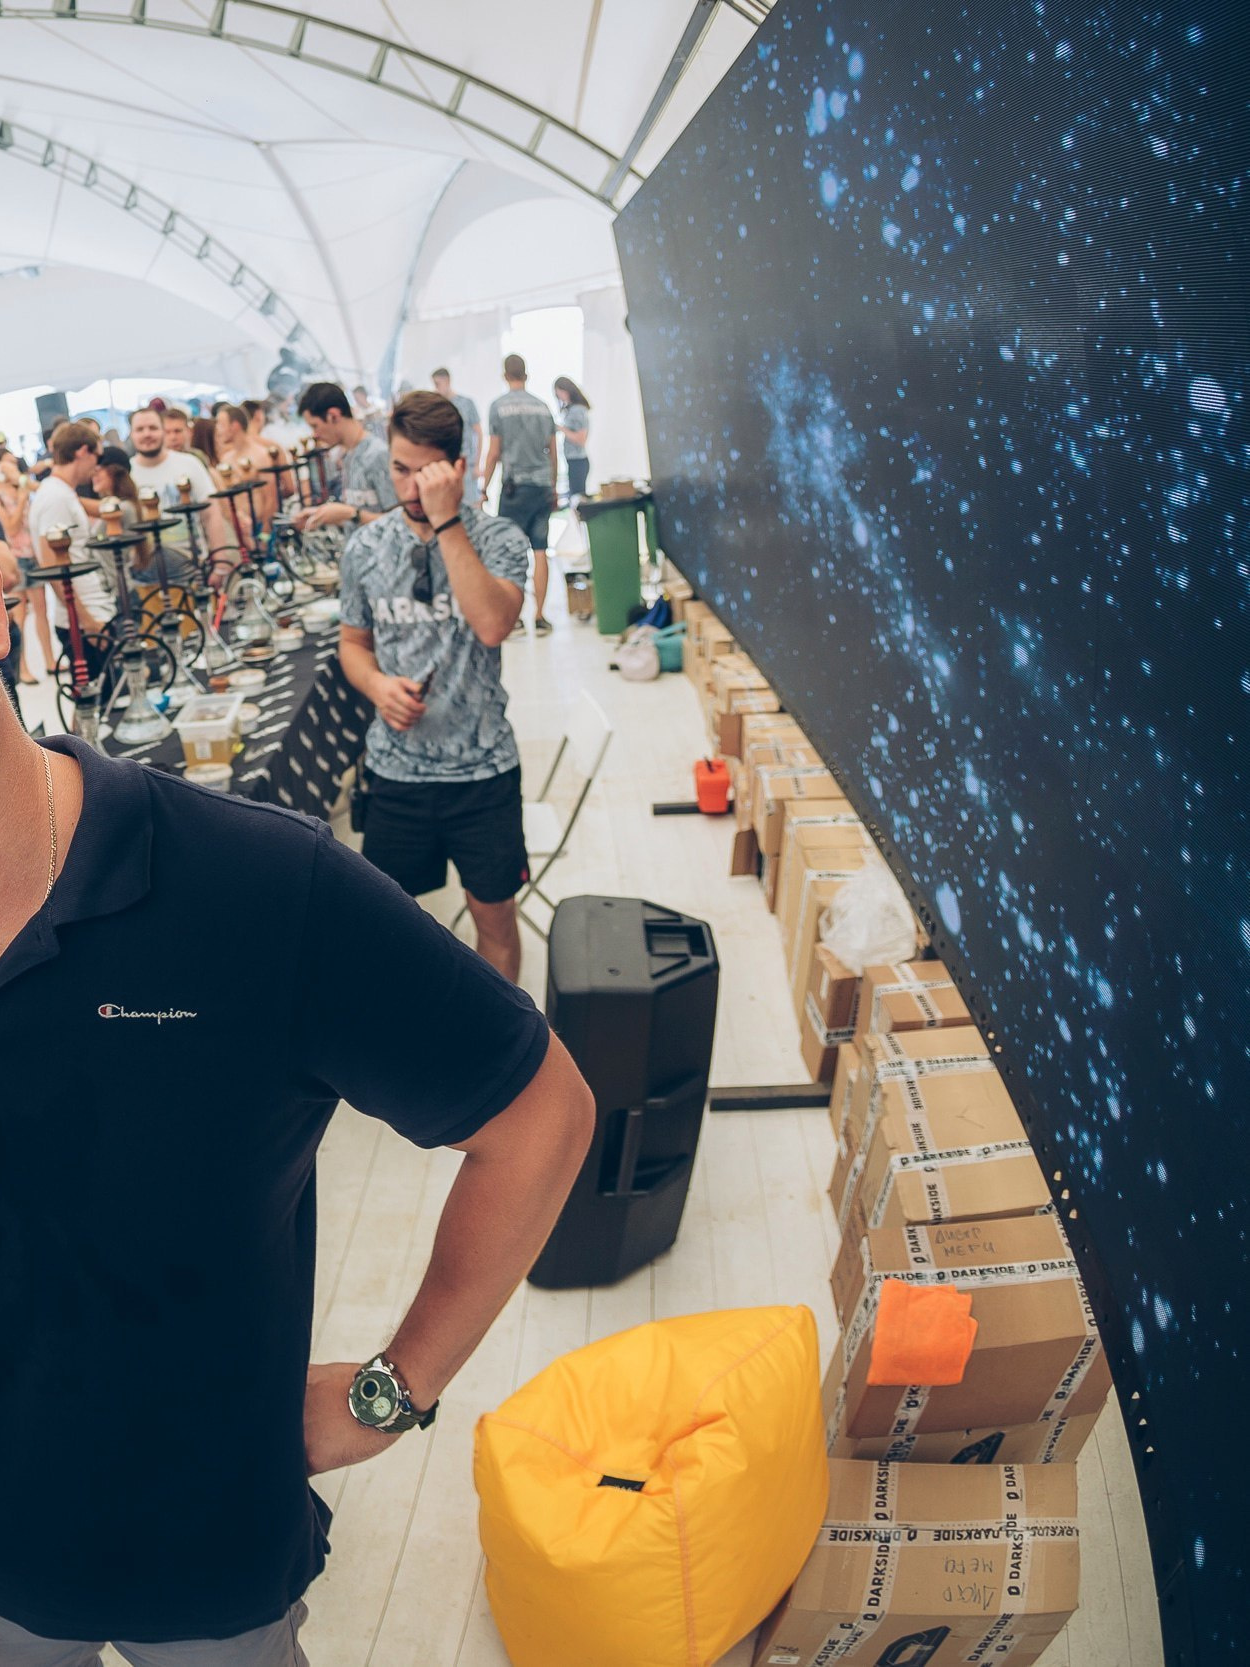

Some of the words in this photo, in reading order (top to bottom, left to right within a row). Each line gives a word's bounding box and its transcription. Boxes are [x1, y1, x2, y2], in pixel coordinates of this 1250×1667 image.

[98, 1003, 197, 1025] Champion
[906, 1225, 922, 1254] DARK
[951, 1264, 1016, 1279] DARKSIDE
[875, 1459, 891, 1508] DARKSID
[867, 1535, 891, 1607] DARKSIDE
[967, 1612, 1015, 1662] DARKSIDE
